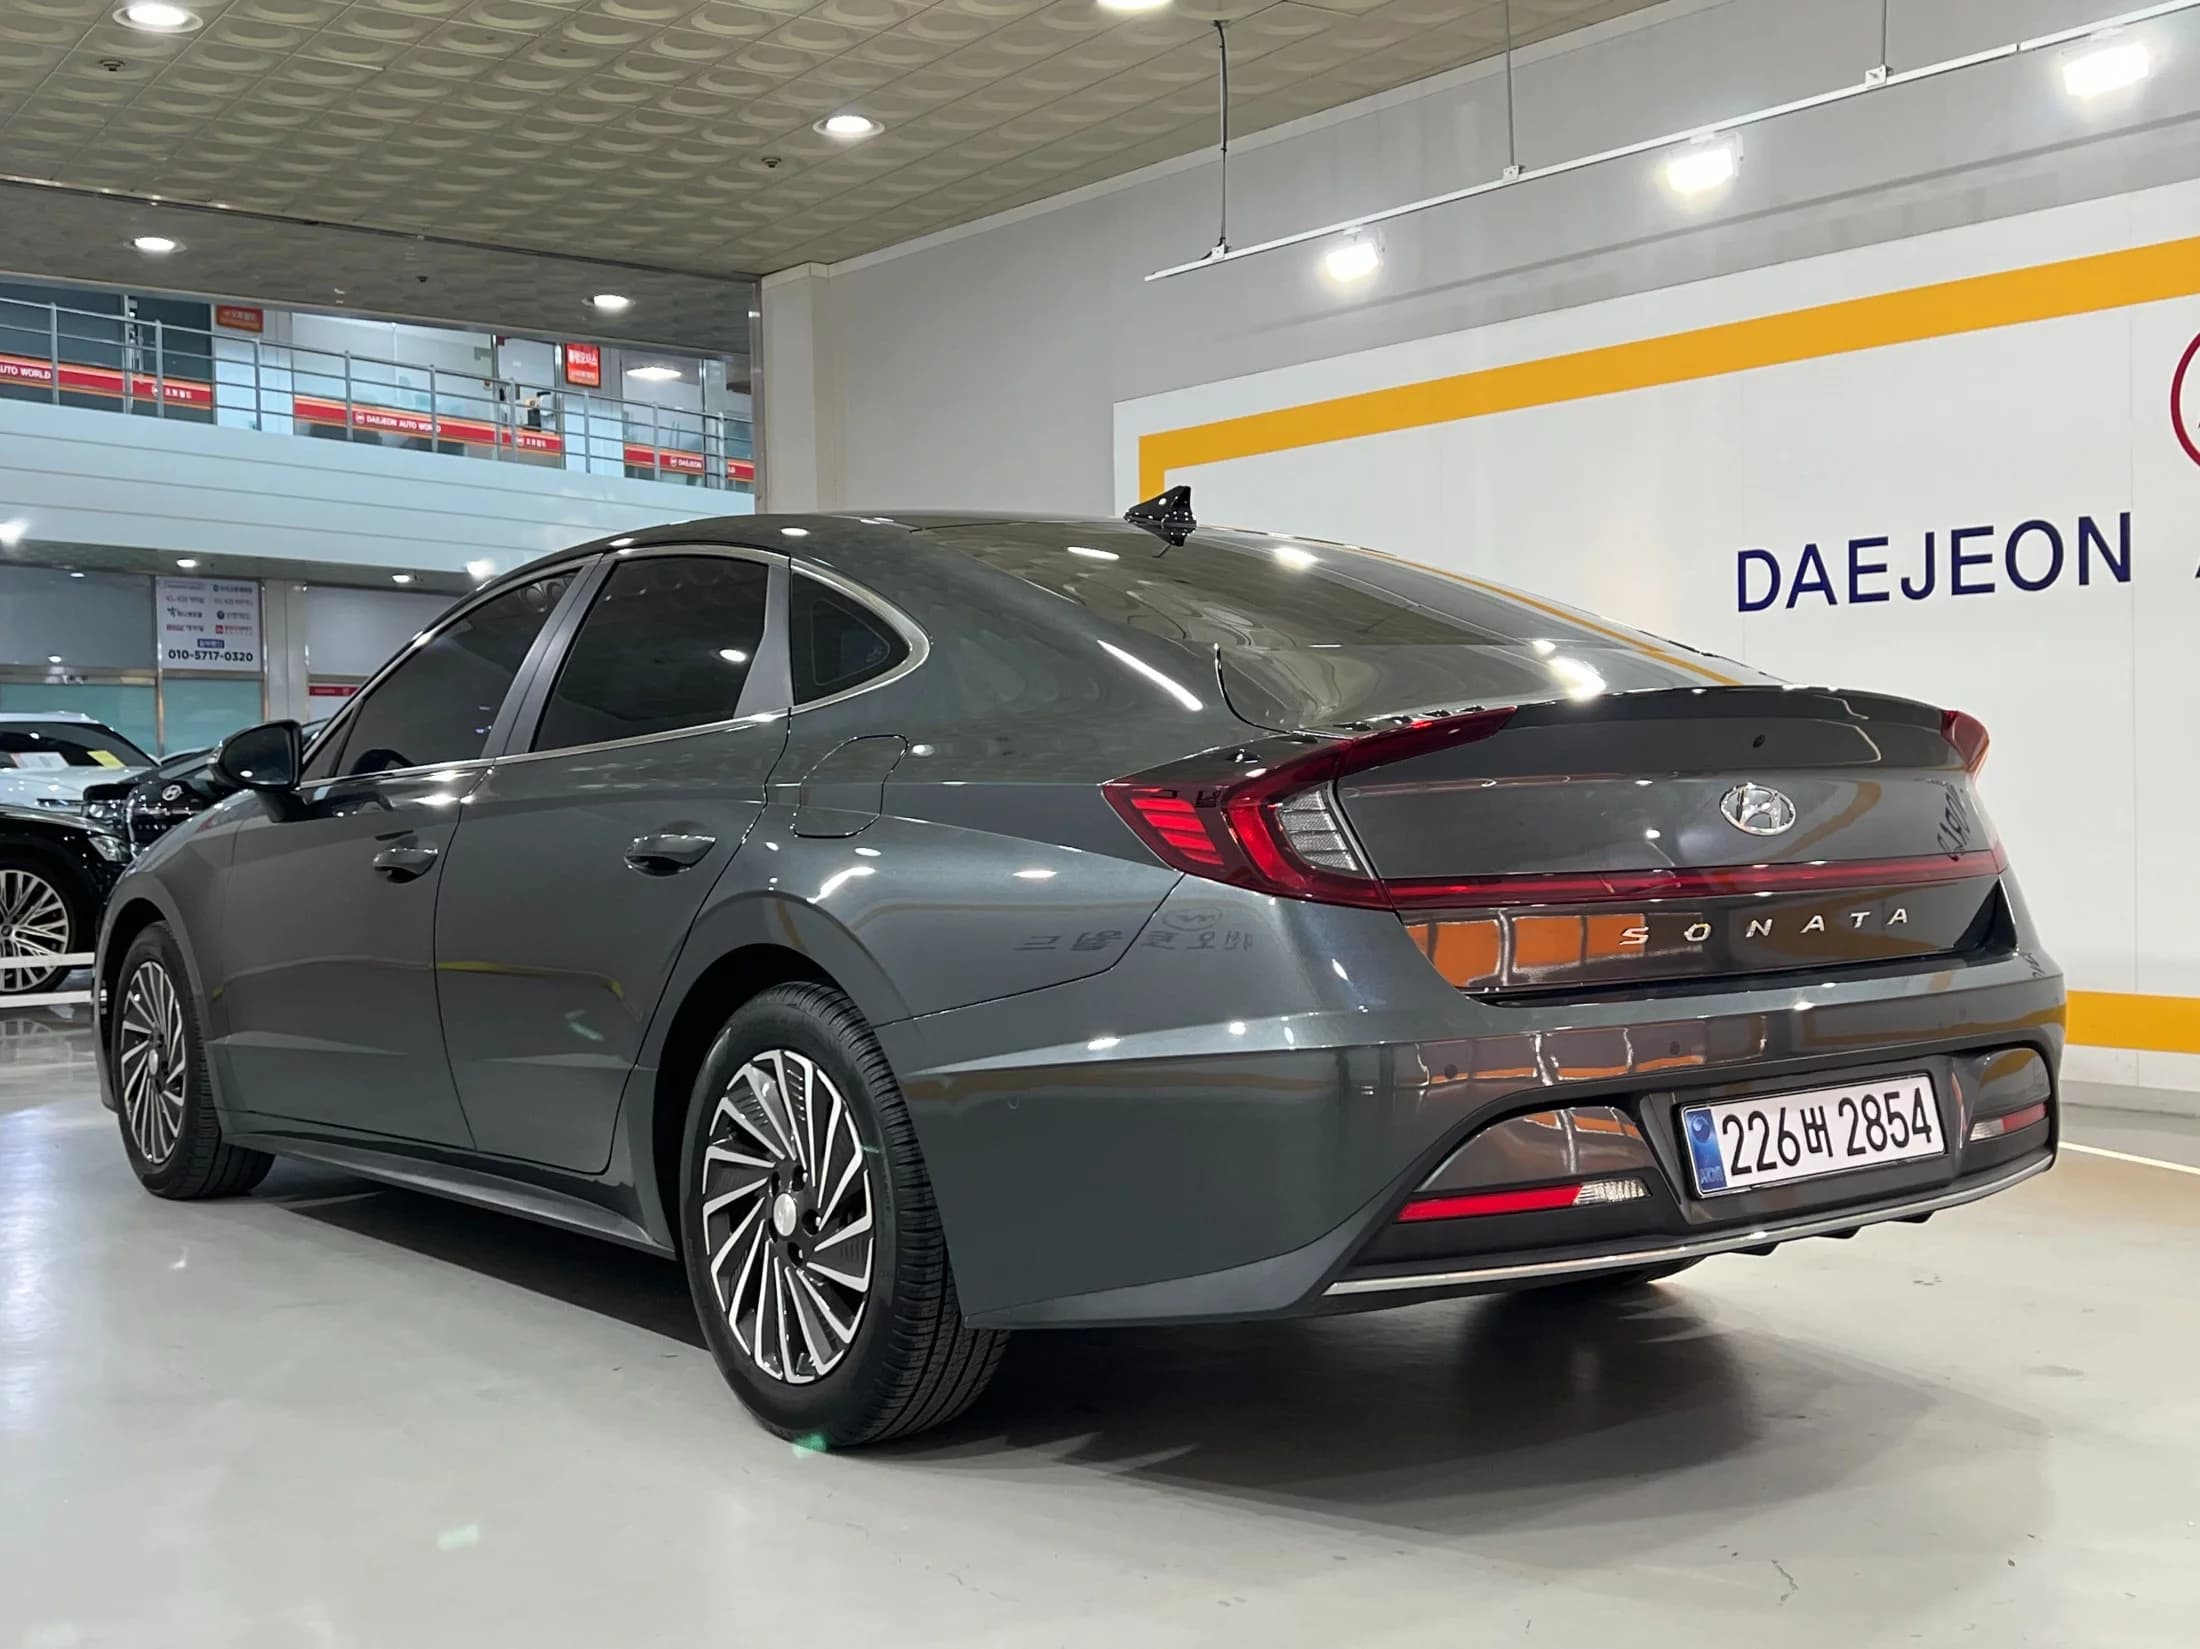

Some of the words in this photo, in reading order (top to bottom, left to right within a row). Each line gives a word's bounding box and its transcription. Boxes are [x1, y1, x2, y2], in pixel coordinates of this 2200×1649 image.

[0, 364, 18, 375] UTO
[20, 368, 51, 379] WORLD
[399, 420, 418, 430] AUTO
[1737, 511, 2132, 613] DAEJEON
[168, 650, 253, 662] 010-5717-0320
[1619, 908, 1909, 946] SONATA
[1721, 1106, 1834, 1177] 226버
[1838, 1087, 1933, 1157] 2854
